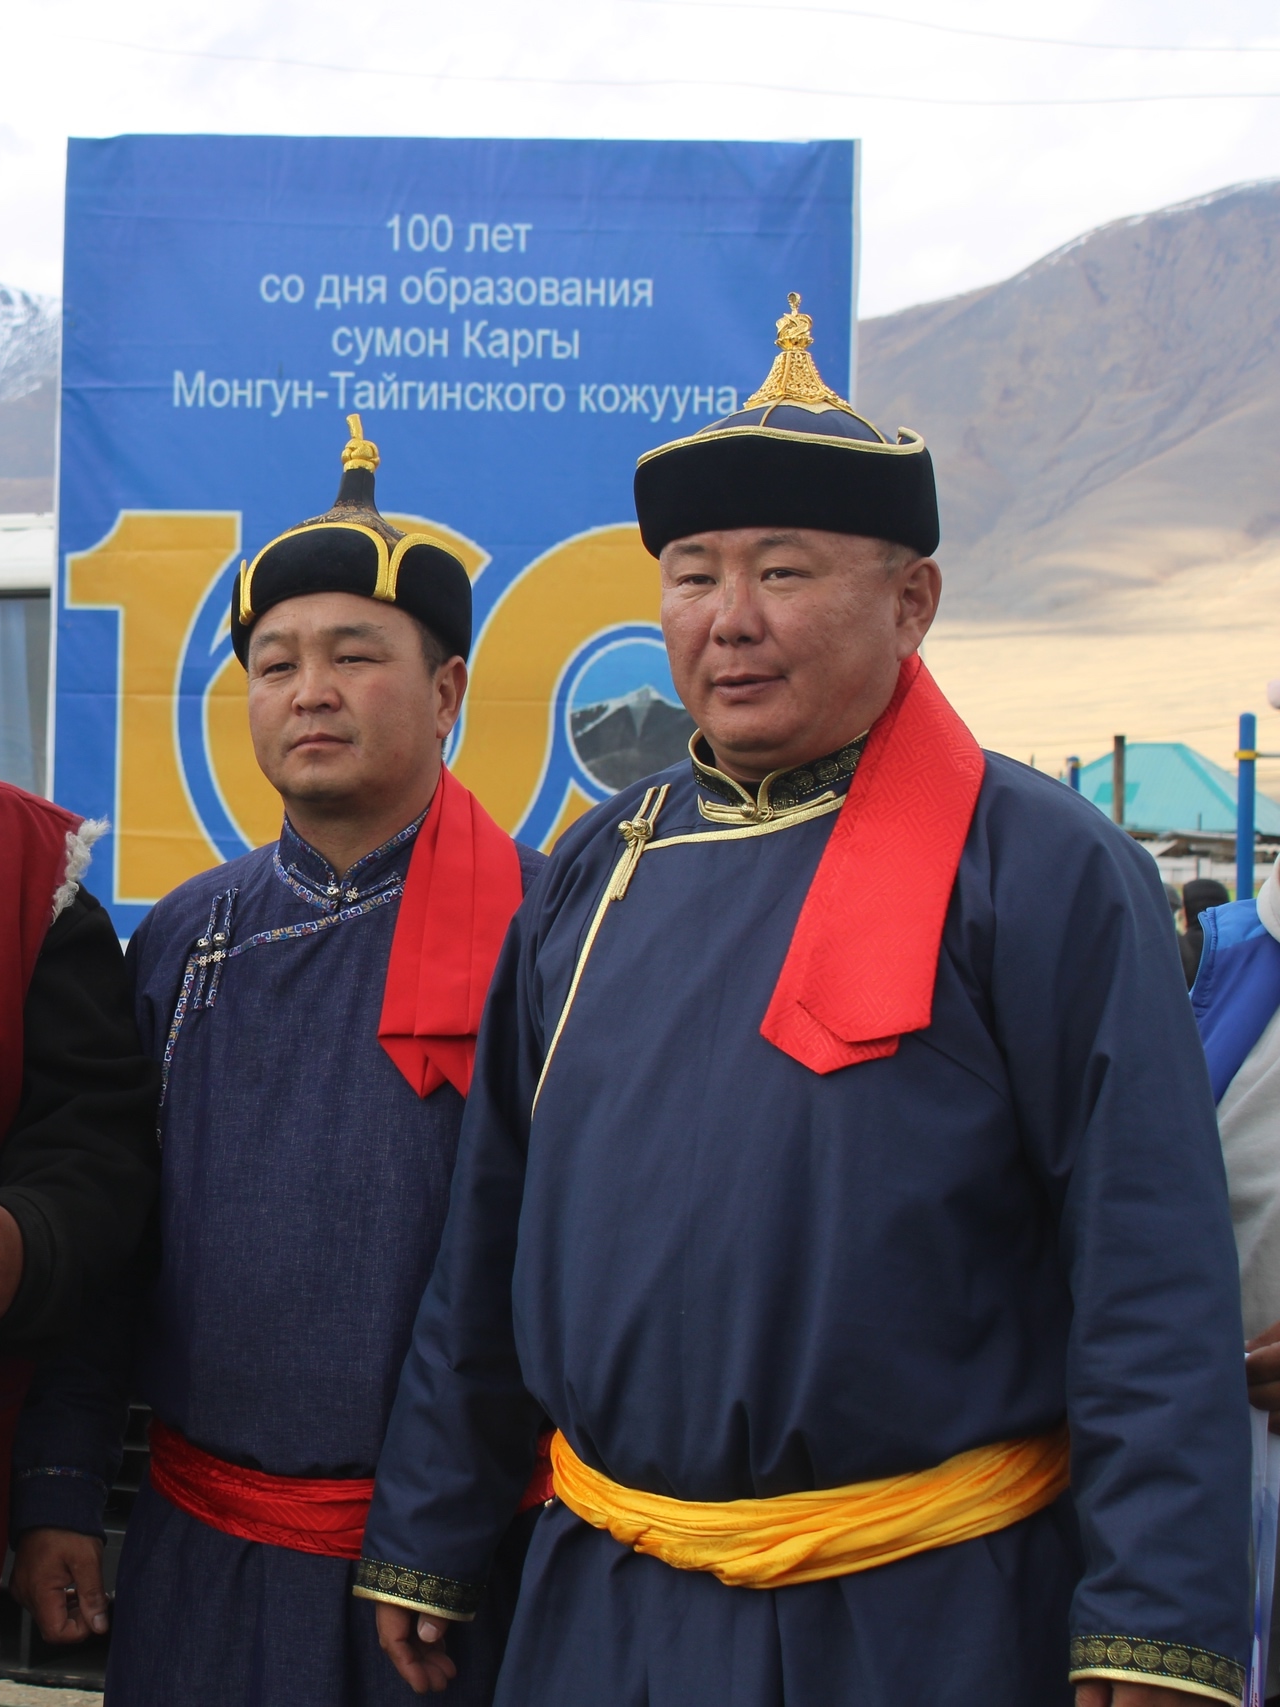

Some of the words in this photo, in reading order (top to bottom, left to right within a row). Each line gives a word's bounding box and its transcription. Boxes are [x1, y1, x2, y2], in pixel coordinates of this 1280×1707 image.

[387, 216, 453, 254] 100
[465, 221, 532, 255] лет
[260, 274, 305, 304] со
[315, 274, 387, 308] дня
[399, 268, 654, 312] образования
[332, 329, 449, 365] сумон
[463, 321, 580, 366] Каргы
[172, 370, 565, 418] Монгун-Тайгинского
[578, 384, 738, 424] кожууна
